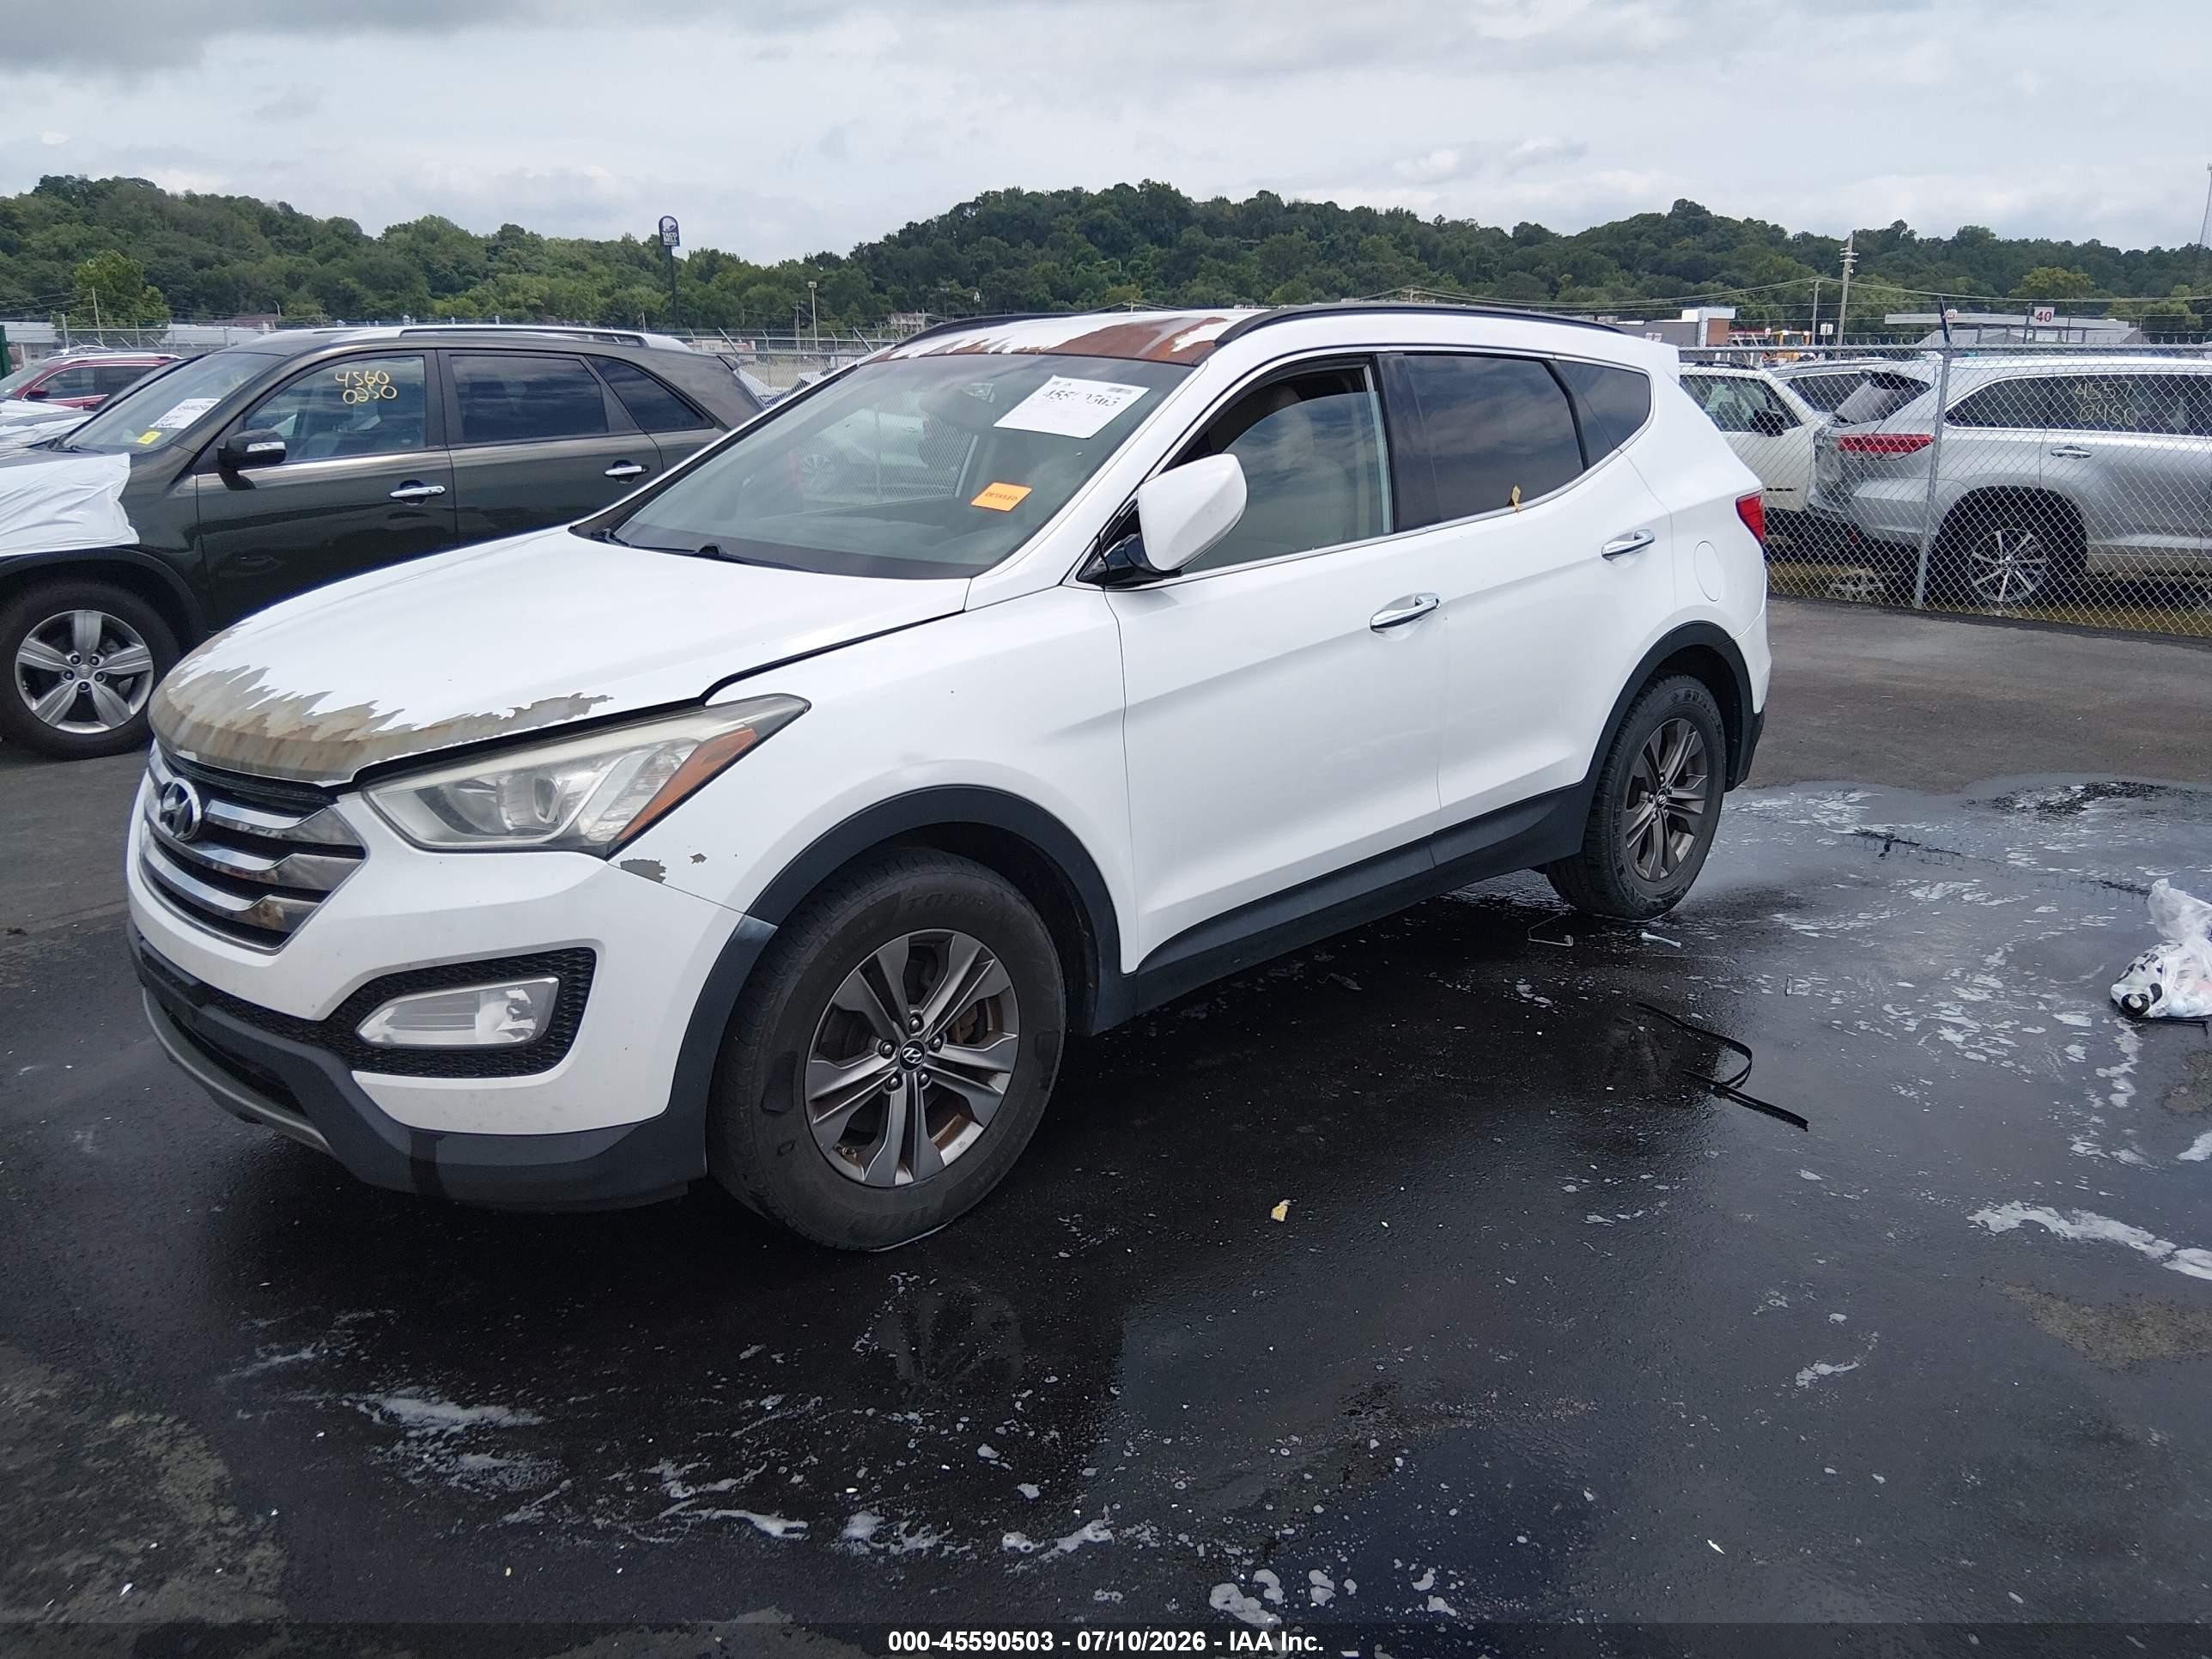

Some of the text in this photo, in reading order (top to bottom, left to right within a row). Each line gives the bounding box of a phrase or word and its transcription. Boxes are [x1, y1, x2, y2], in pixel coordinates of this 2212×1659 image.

[2035, 311, 2052, 323] 40
[335, 370, 390, 388] 4560
[343, 384, 398, 404] 0250
[984, 491, 1018, 501] DETAILED
